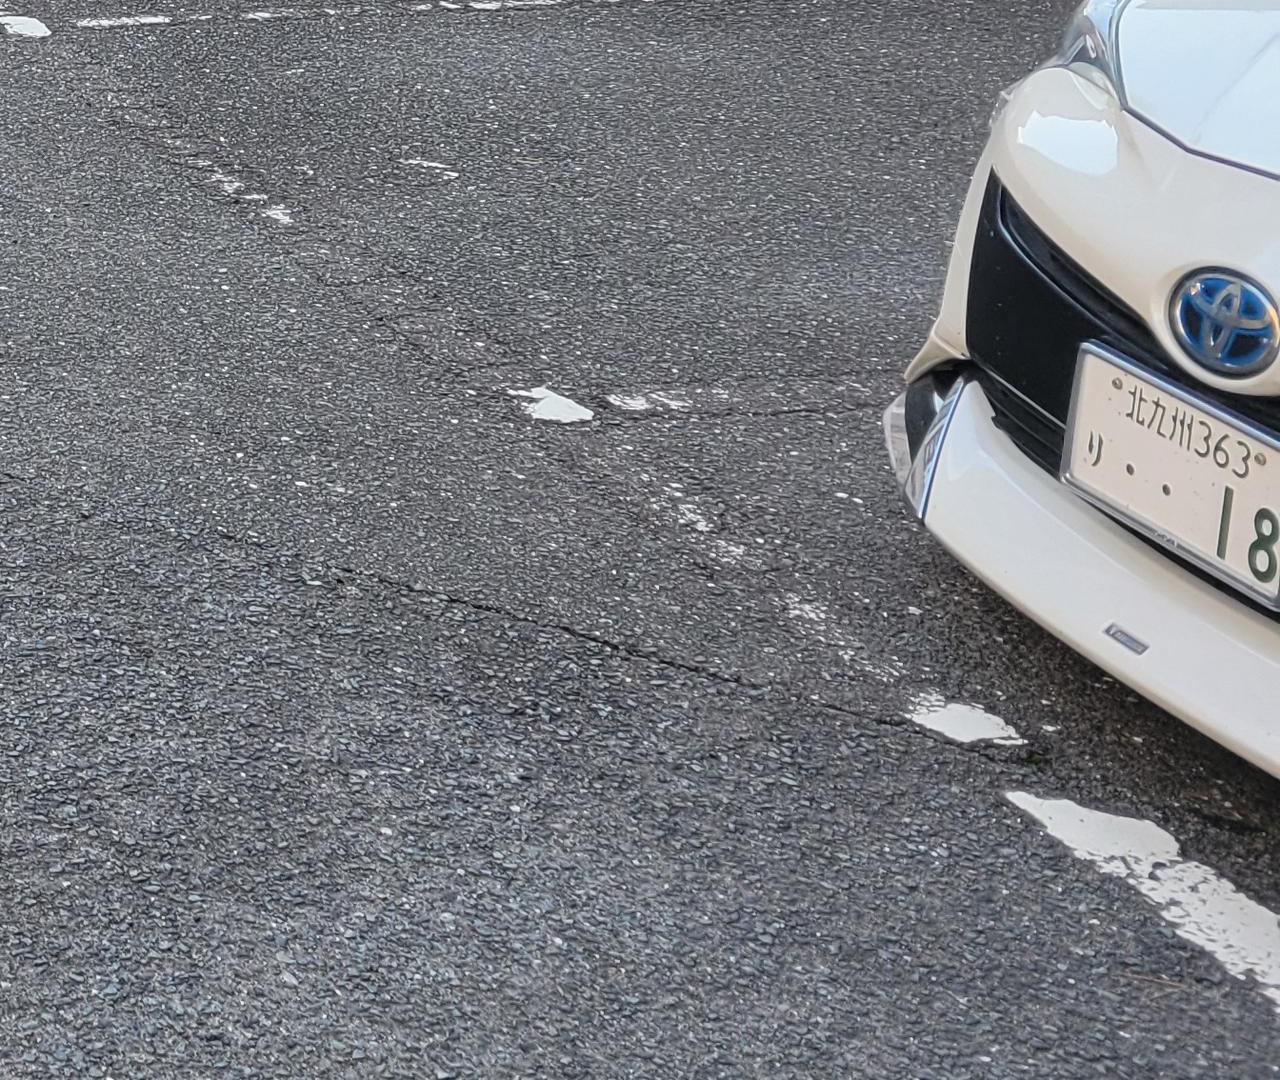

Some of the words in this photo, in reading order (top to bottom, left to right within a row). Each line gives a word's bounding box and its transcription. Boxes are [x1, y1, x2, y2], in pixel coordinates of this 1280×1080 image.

[1088, 431, 1104, 467] り
[1126, 385, 1251, 479] 北九州363
